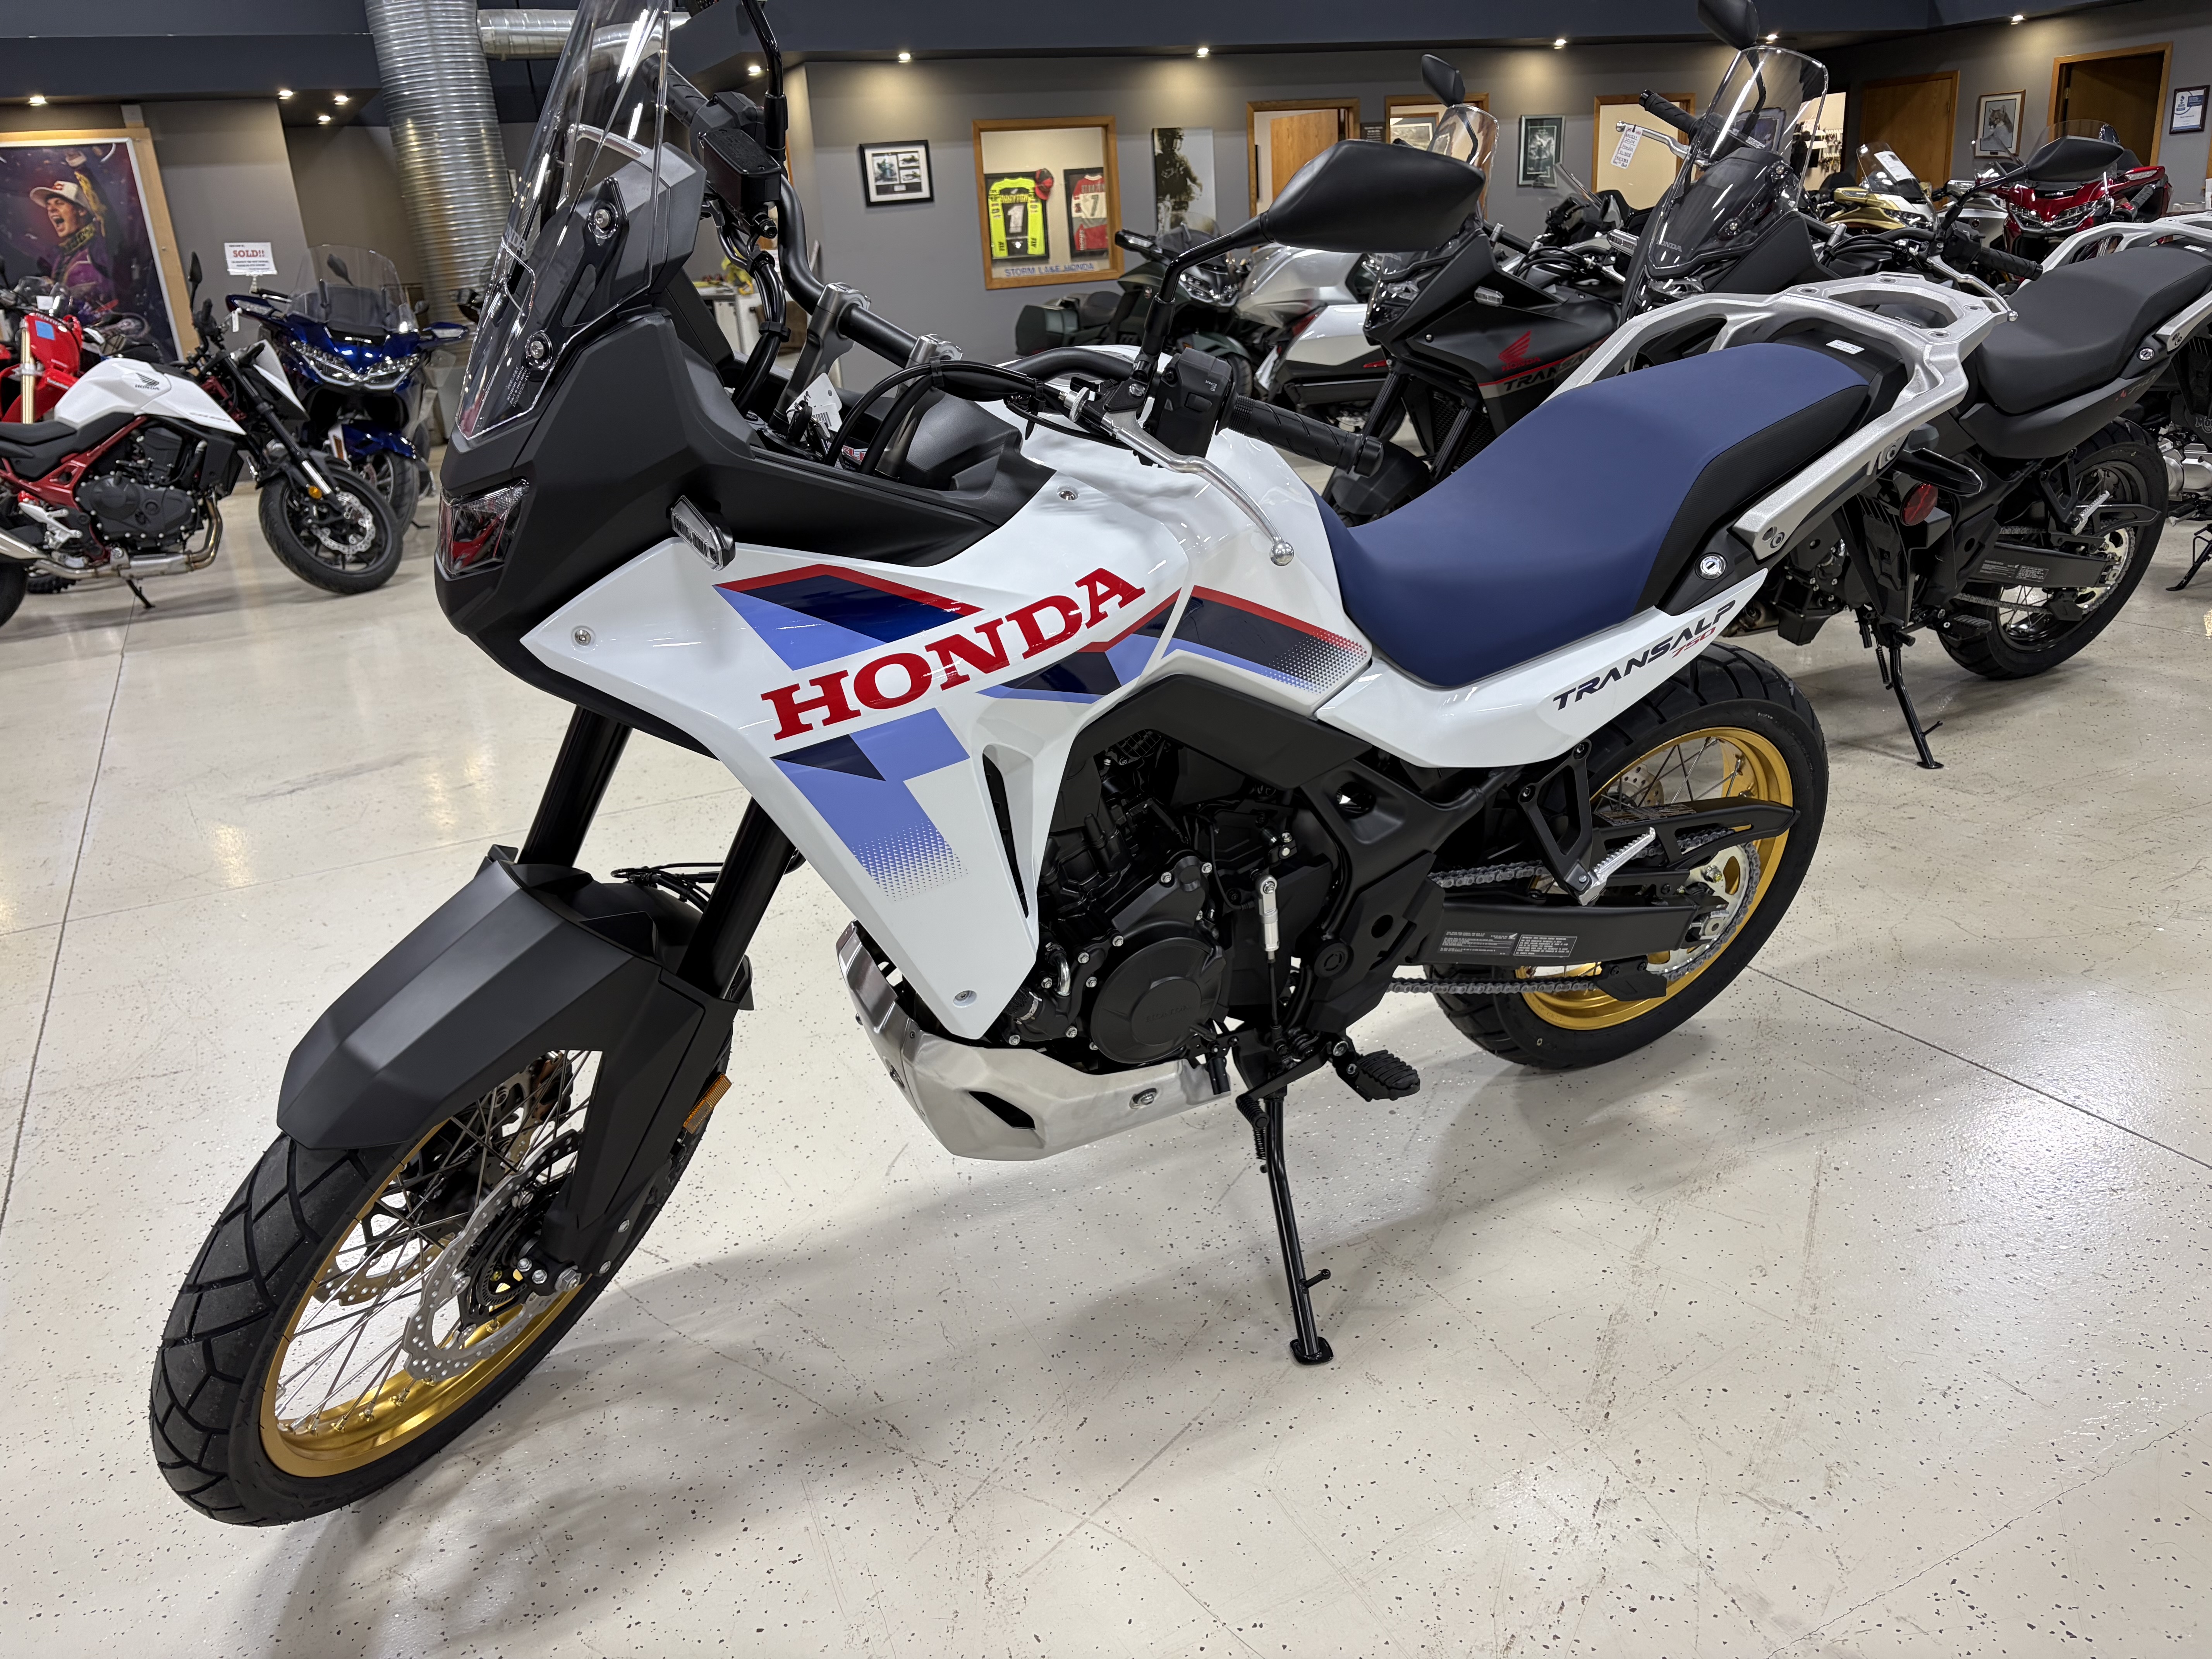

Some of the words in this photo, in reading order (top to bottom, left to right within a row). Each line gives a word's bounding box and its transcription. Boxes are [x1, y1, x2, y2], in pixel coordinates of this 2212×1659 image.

[1091, 194, 1099, 216] 7
[1007, 204, 1025, 233] 1
[233, 249, 265, 258] SOLD!!
[1005, 267, 1036, 276] STORM
[1063, 263, 1094, 272] HONDA
[1501, 356, 1541, 372] HONDA
[761, 568, 1146, 741] HONDA
[1553, 599, 1736, 711] TRANSALP
[1671, 627, 1716, 659] 750
